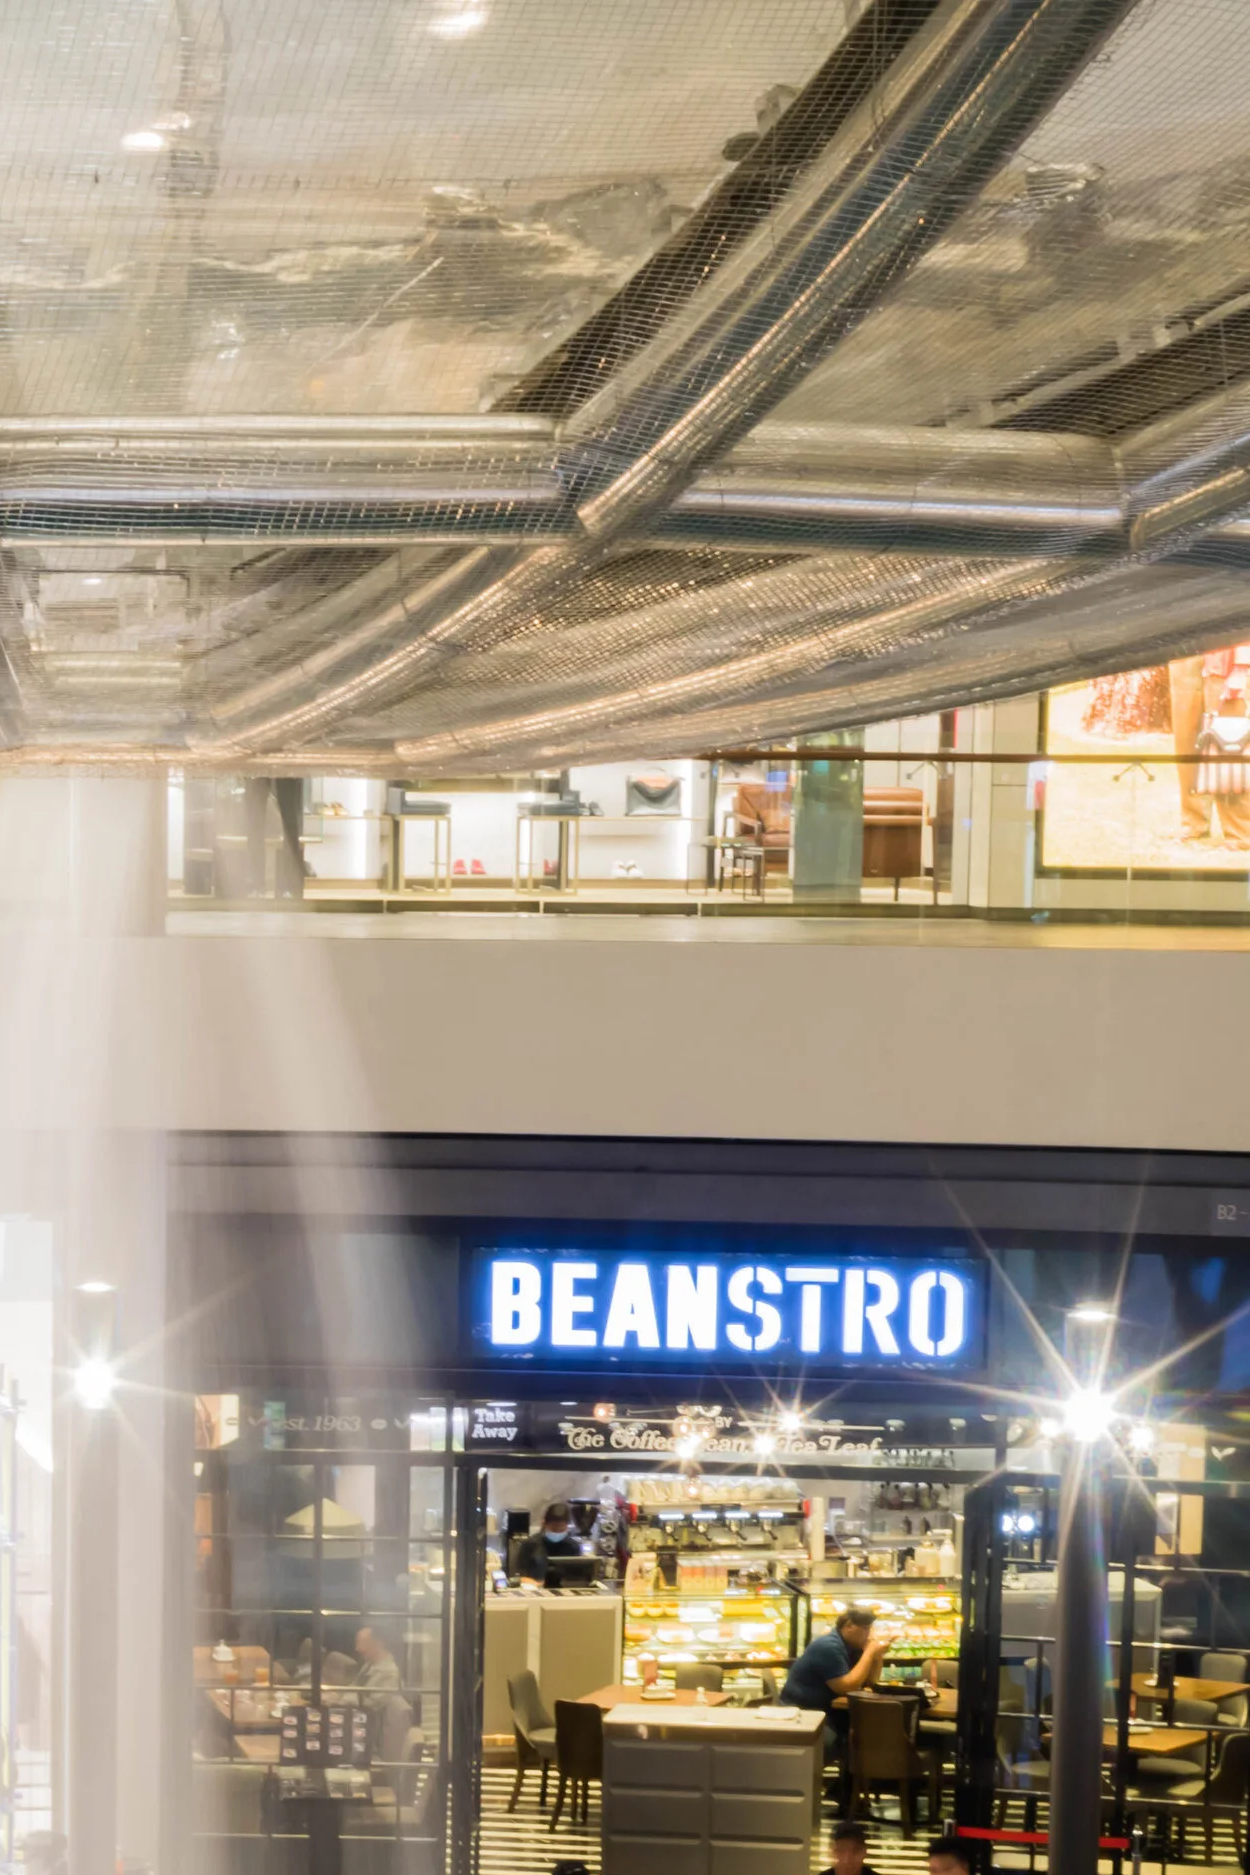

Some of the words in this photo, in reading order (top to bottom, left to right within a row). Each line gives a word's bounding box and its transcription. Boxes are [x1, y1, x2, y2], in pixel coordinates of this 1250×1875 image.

[491, 1261, 965, 1357] BEANSTRO
[312, 1415, 362, 1432] 1963
[475, 1408, 516, 1424] Take
[472, 1425, 518, 1442] Away
[566, 1427, 605, 1451] The
[609, 1428, 678, 1452] Coffee
